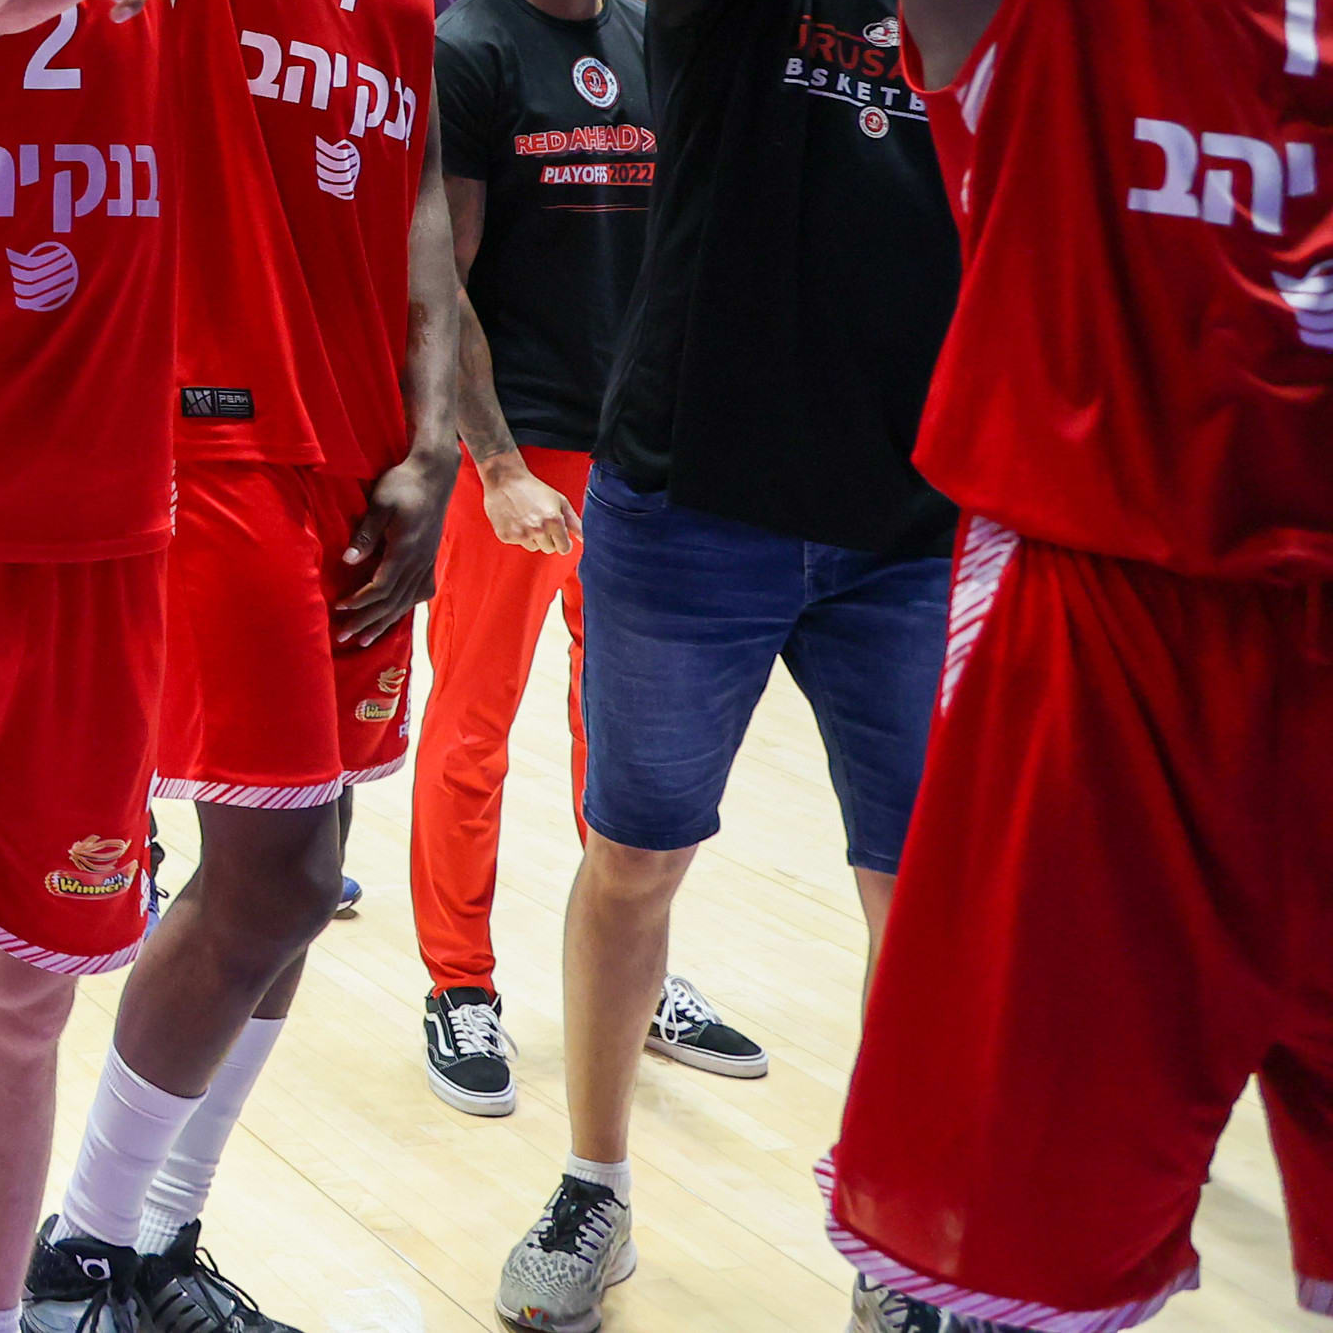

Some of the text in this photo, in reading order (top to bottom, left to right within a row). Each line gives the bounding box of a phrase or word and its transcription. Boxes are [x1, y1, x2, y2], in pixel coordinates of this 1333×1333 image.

[23, 4, 82, 90] 2
[240, 30, 347, 110] יהב
[515, 124, 639, 154] RED AHEAD
[543, 163, 652, 184] PLAYOFFS 2022
[1127, 117, 1316, 236] יהב
[60, 876, 123, 894] Winner
